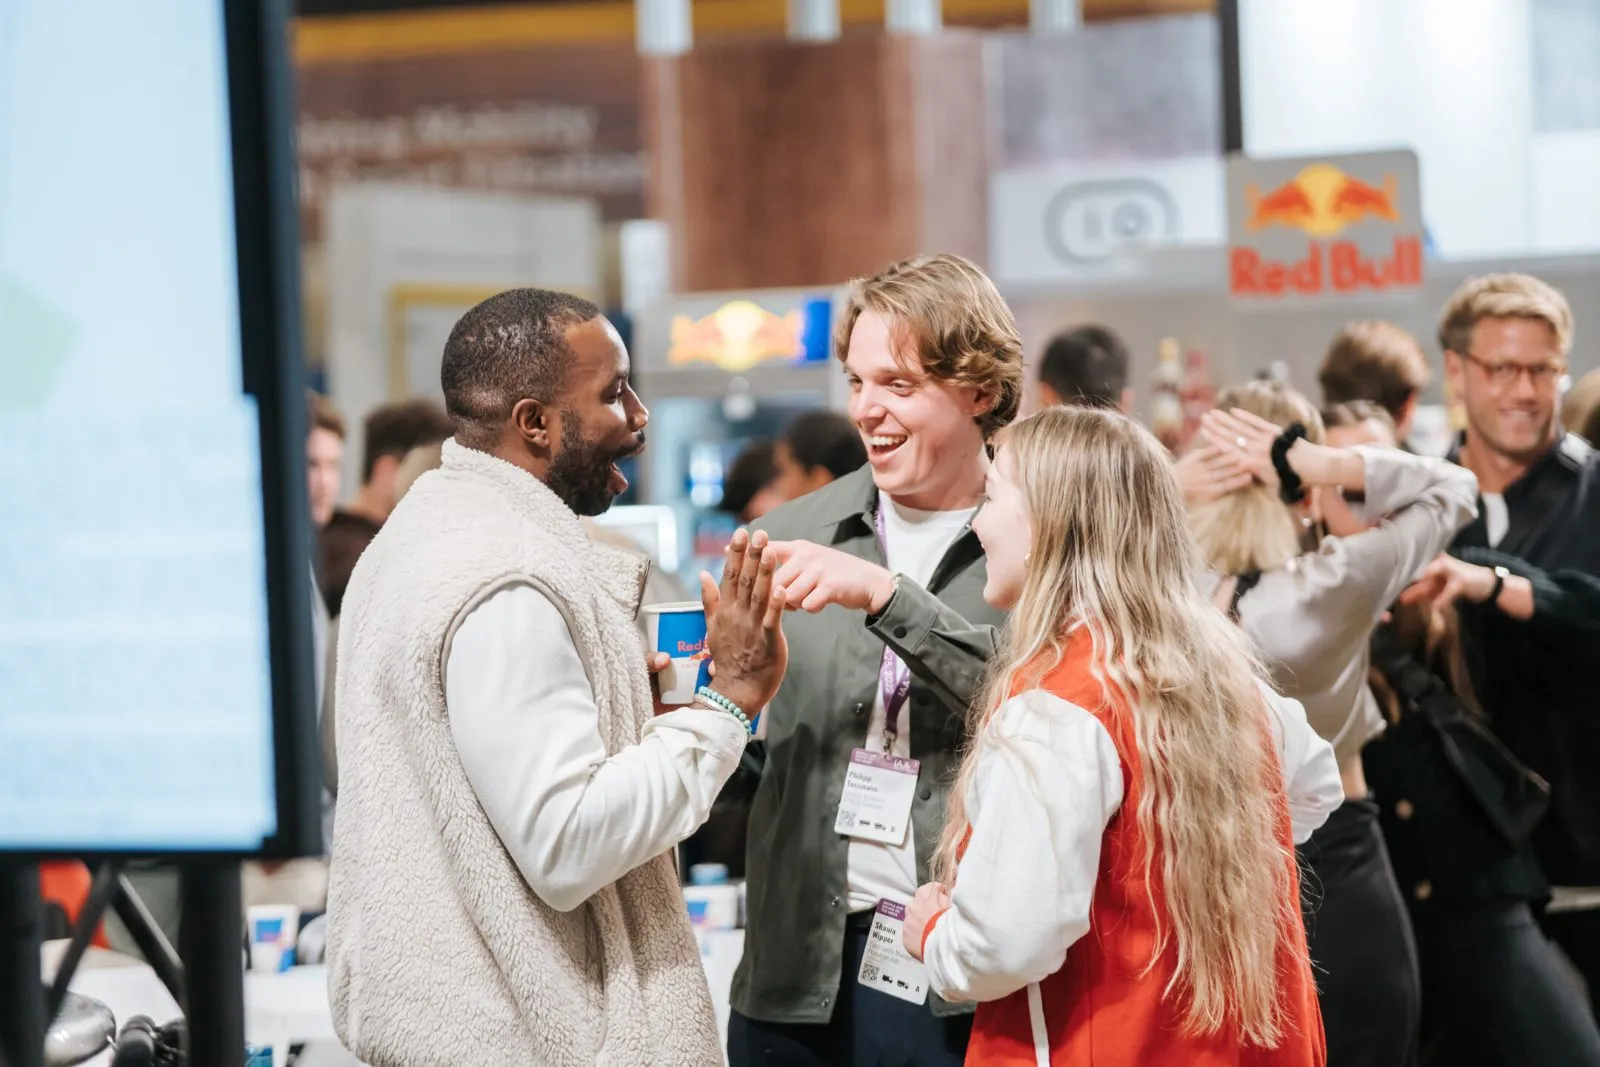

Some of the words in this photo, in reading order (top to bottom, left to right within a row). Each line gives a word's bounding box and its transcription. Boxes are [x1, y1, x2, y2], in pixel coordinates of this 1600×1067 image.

[1230, 241, 1321, 294] Red
[1330, 236, 1421, 292] Bull
[677, 640, 702, 652] Red
[893, 759, 911, 770] IAA
